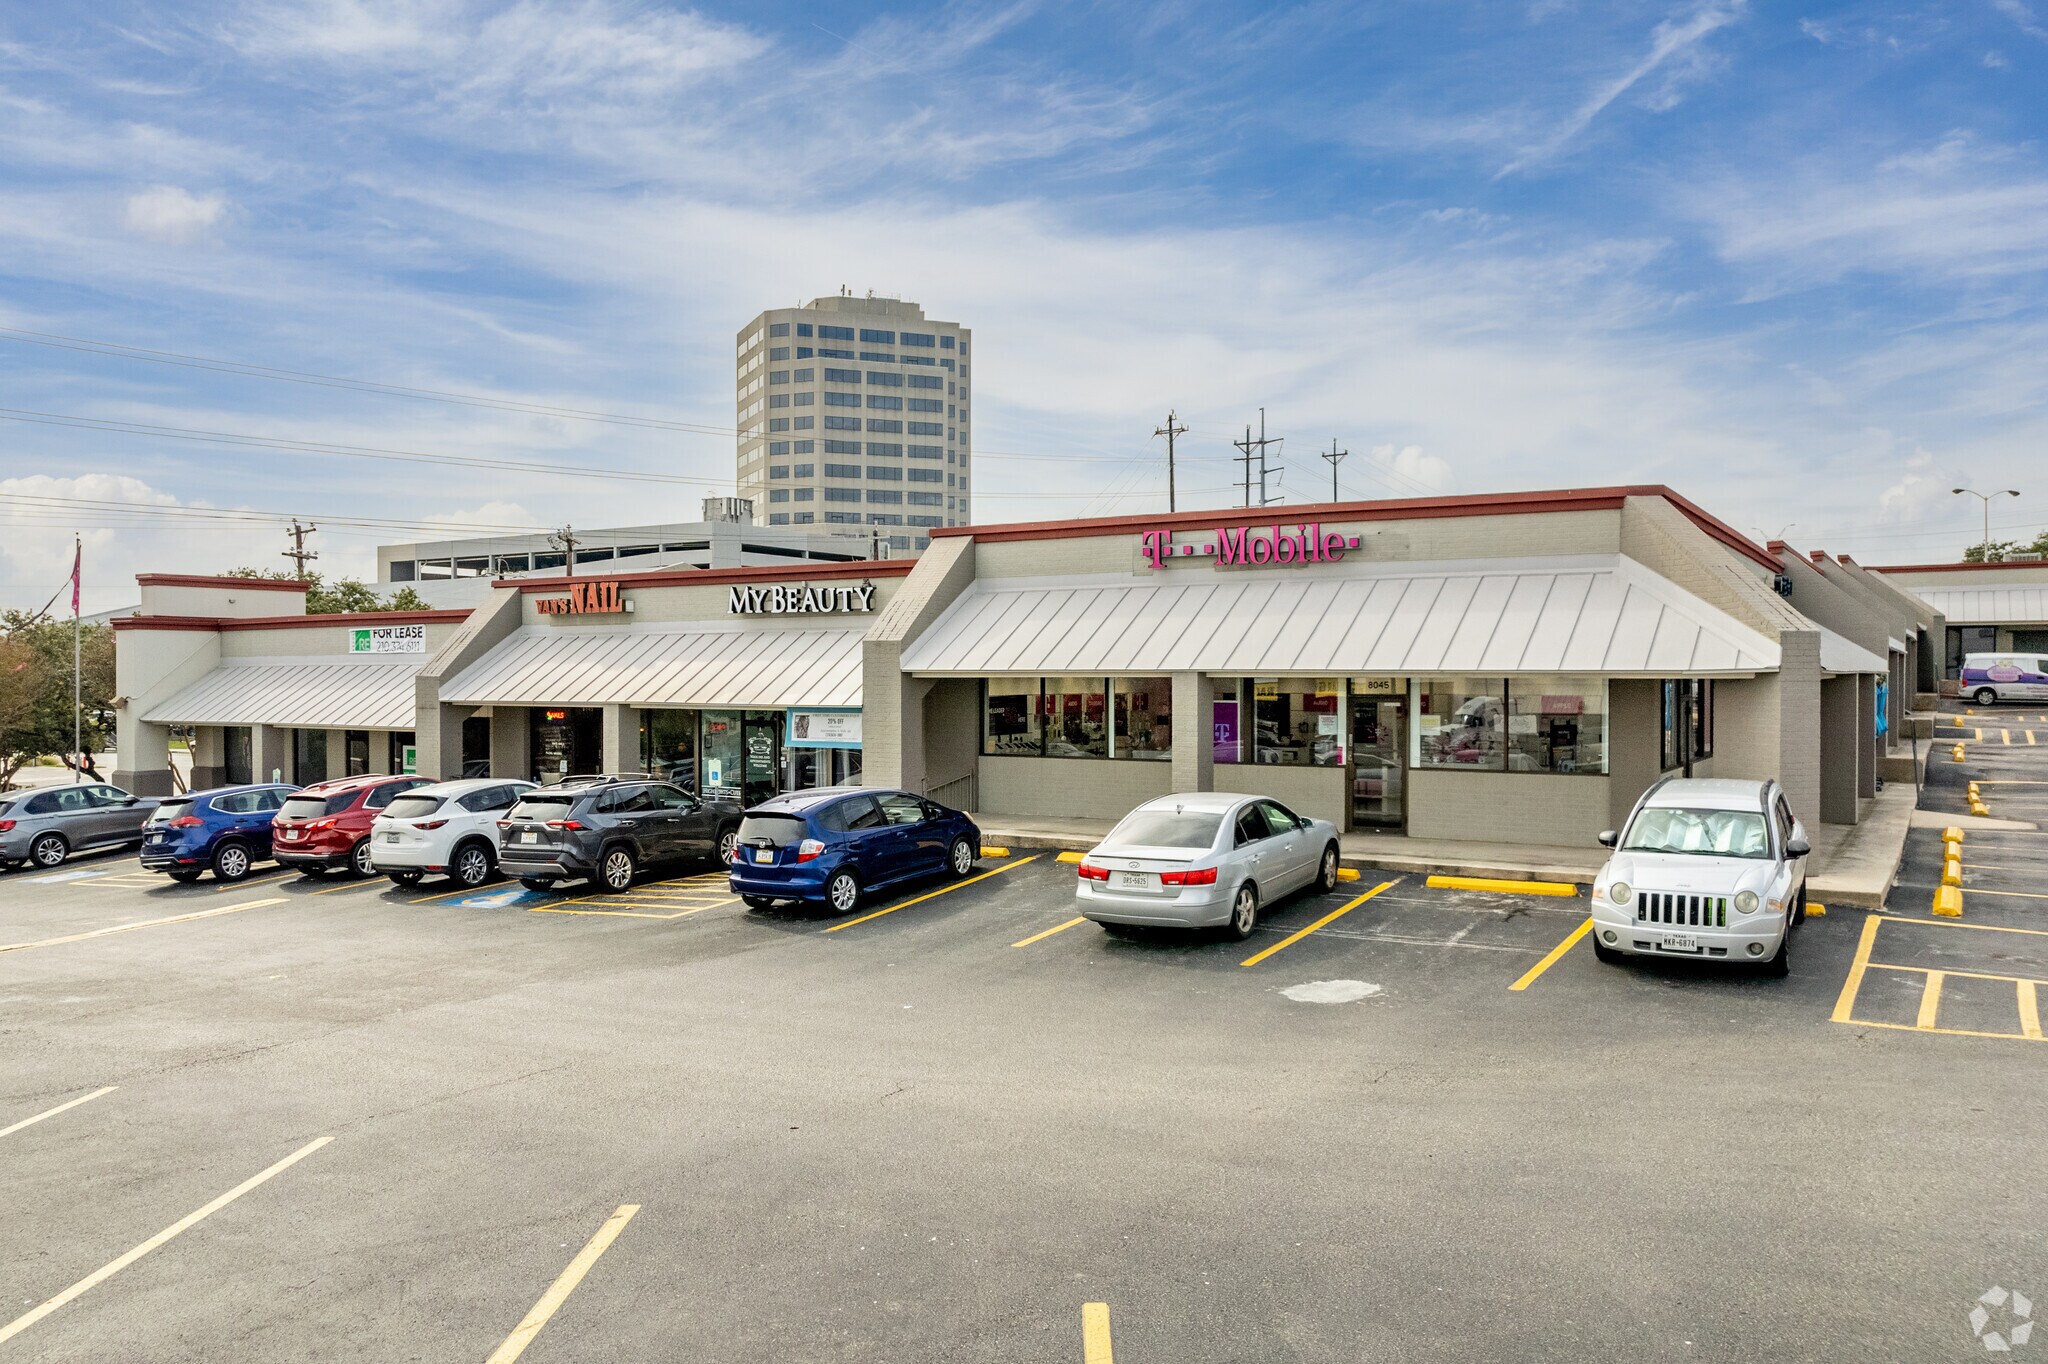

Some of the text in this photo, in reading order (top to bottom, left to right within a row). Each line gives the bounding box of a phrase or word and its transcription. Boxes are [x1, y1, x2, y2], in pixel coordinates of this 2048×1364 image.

[535, 582, 622, 614] VAN'S NAIL
[728, 586, 873, 613] MY BEAUTY
[373, 626, 423, 638] FOR LEASE
[1368, 681, 1389, 689] 8045
